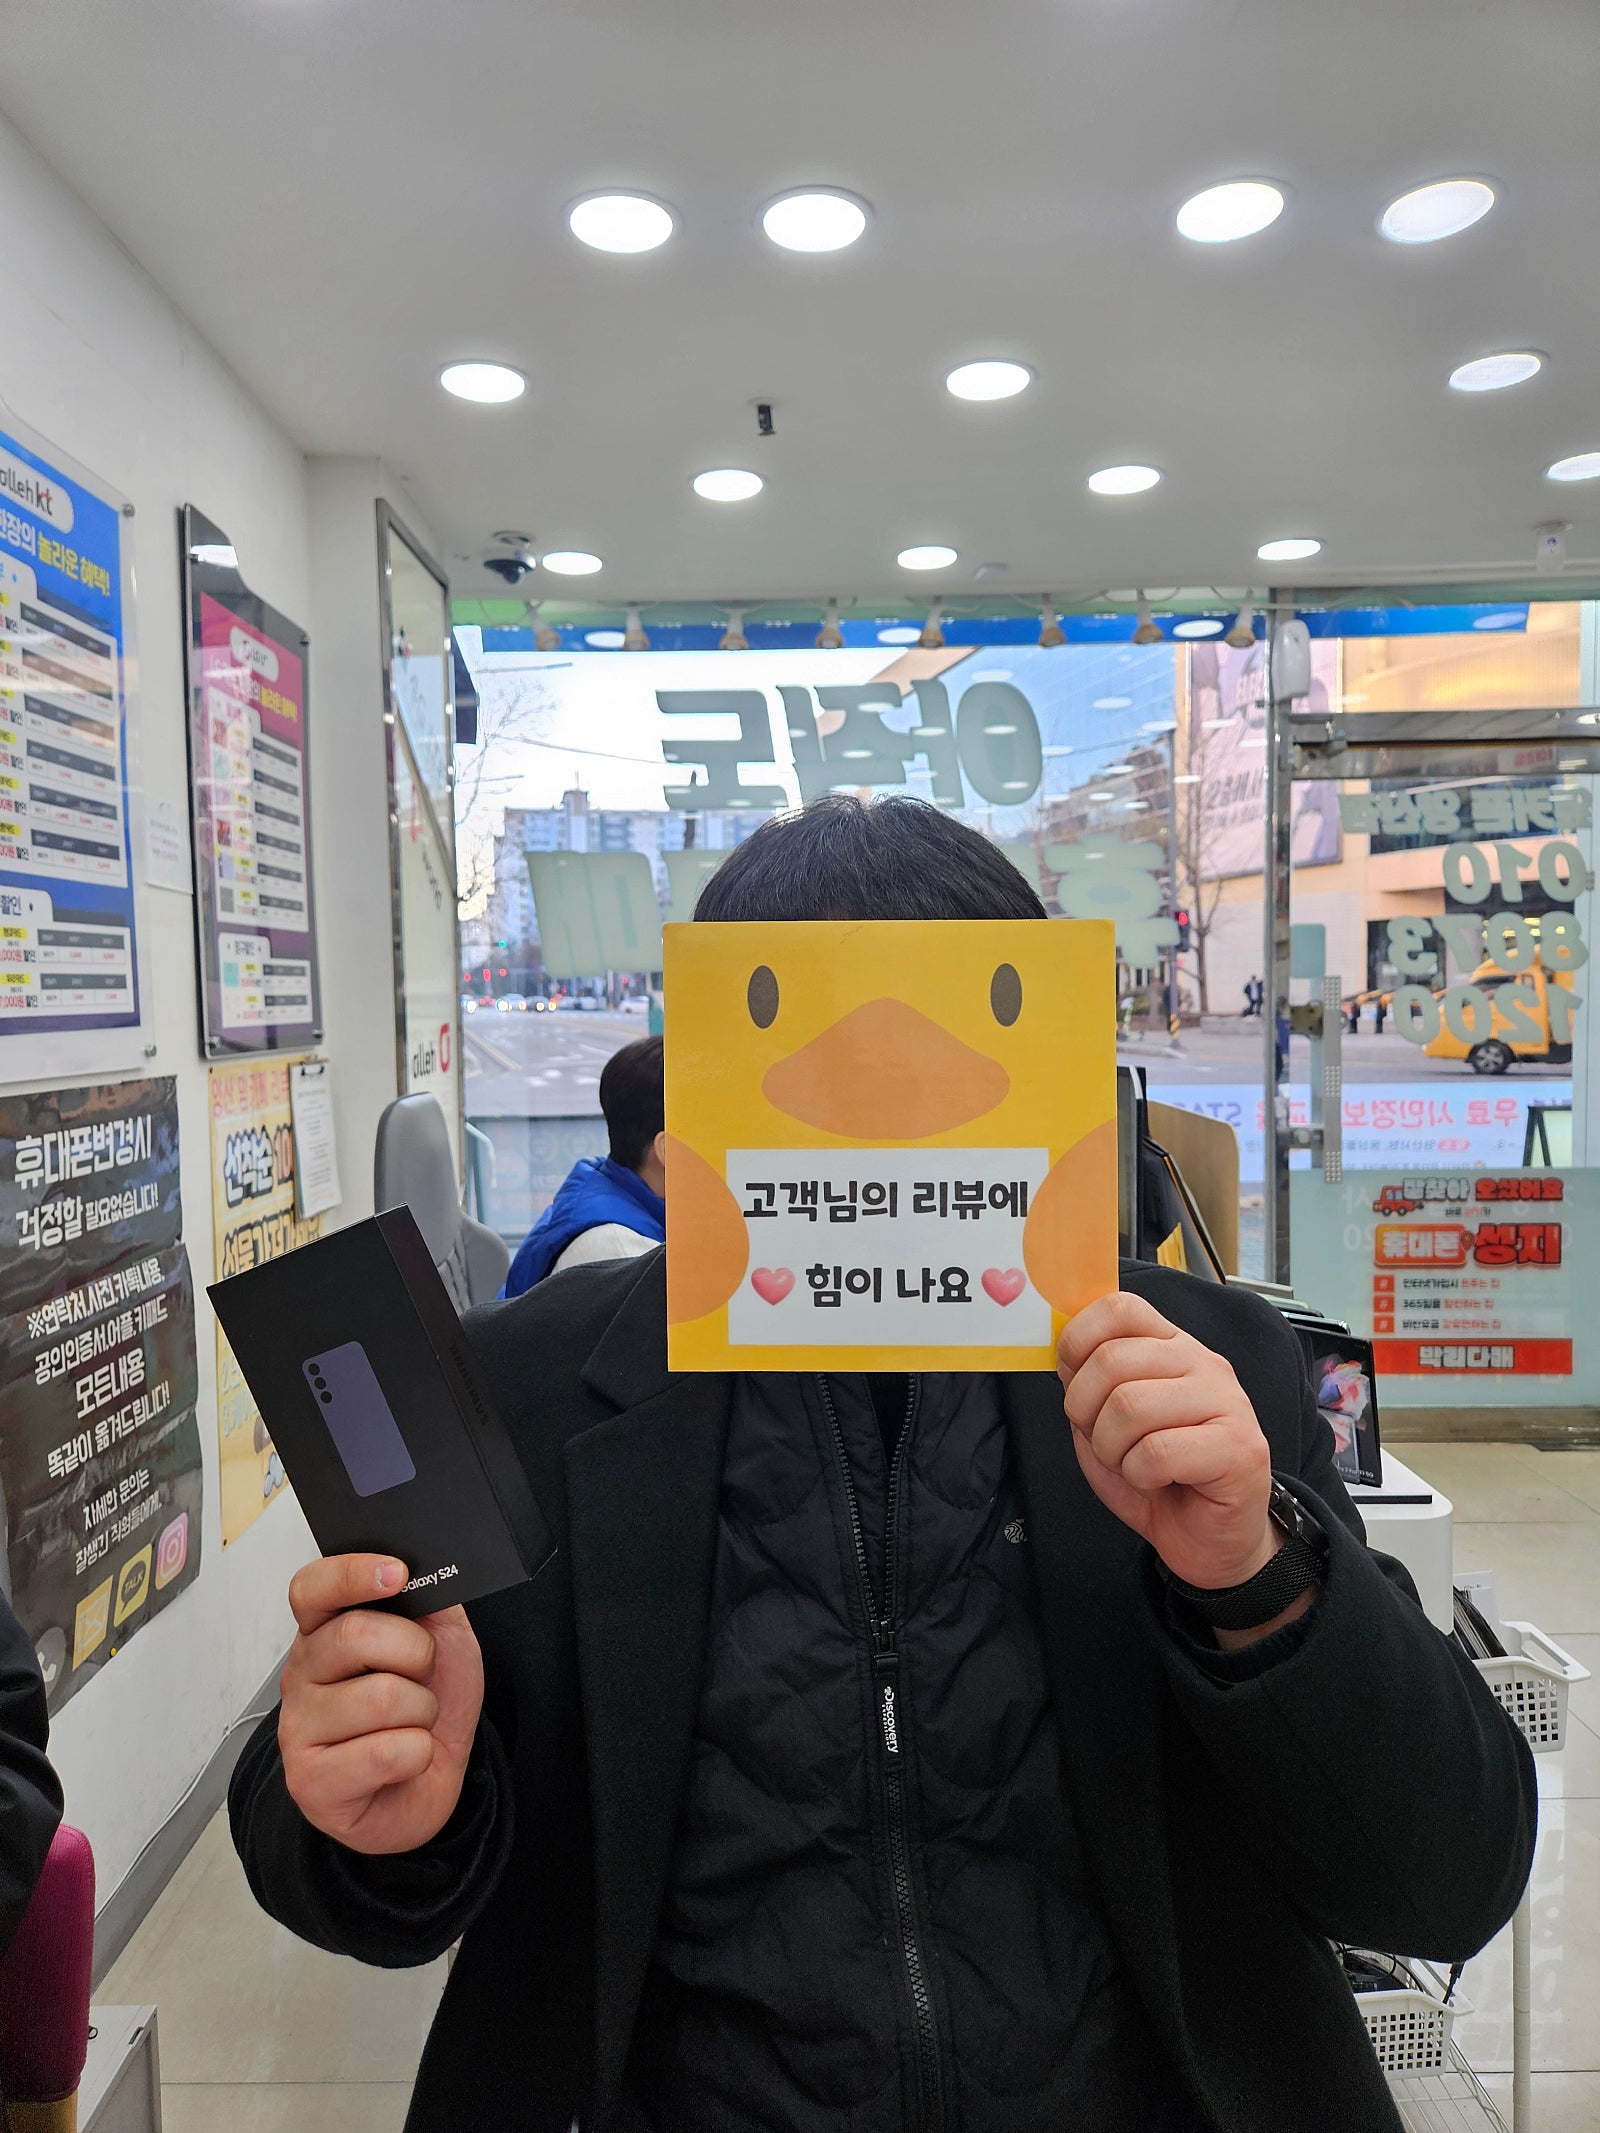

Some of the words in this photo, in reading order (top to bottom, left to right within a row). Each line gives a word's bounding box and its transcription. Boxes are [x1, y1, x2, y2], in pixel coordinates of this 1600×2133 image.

[36, 481, 52, 517] kt
[37, 531, 79, 581] 놀라운
[14, 1113, 152, 1191] 휴대폰변경시
[224, 1124, 273, 1208] 선착순
[15, 1195, 83, 1252] 걱정할
[85, 1181, 160, 1232] 필요없습니다!
[742, 1180, 898, 1223] 고객님의
[912, 1180, 1029, 1221] 리뷰에
[1473, 1222, 1562, 1266] 성지
[805, 1263, 883, 1308] 힘이
[896, 1266, 973, 1304] 나요
[75, 1347, 146, 1420] 모든내용
[47, 1429, 93, 1479] 똑같이
[94, 1380, 171, 1454] 옮겨드립니다!
[82, 1487, 118, 1531] 자세한
[119, 1467, 150, 1505] 문의는
[75, 1530, 109, 1576] 잘생긴
[437, 1563, 460, 1581] S24
[124, 1569, 145, 1596] TALK
[884, 1691, 900, 1754] Discovery
